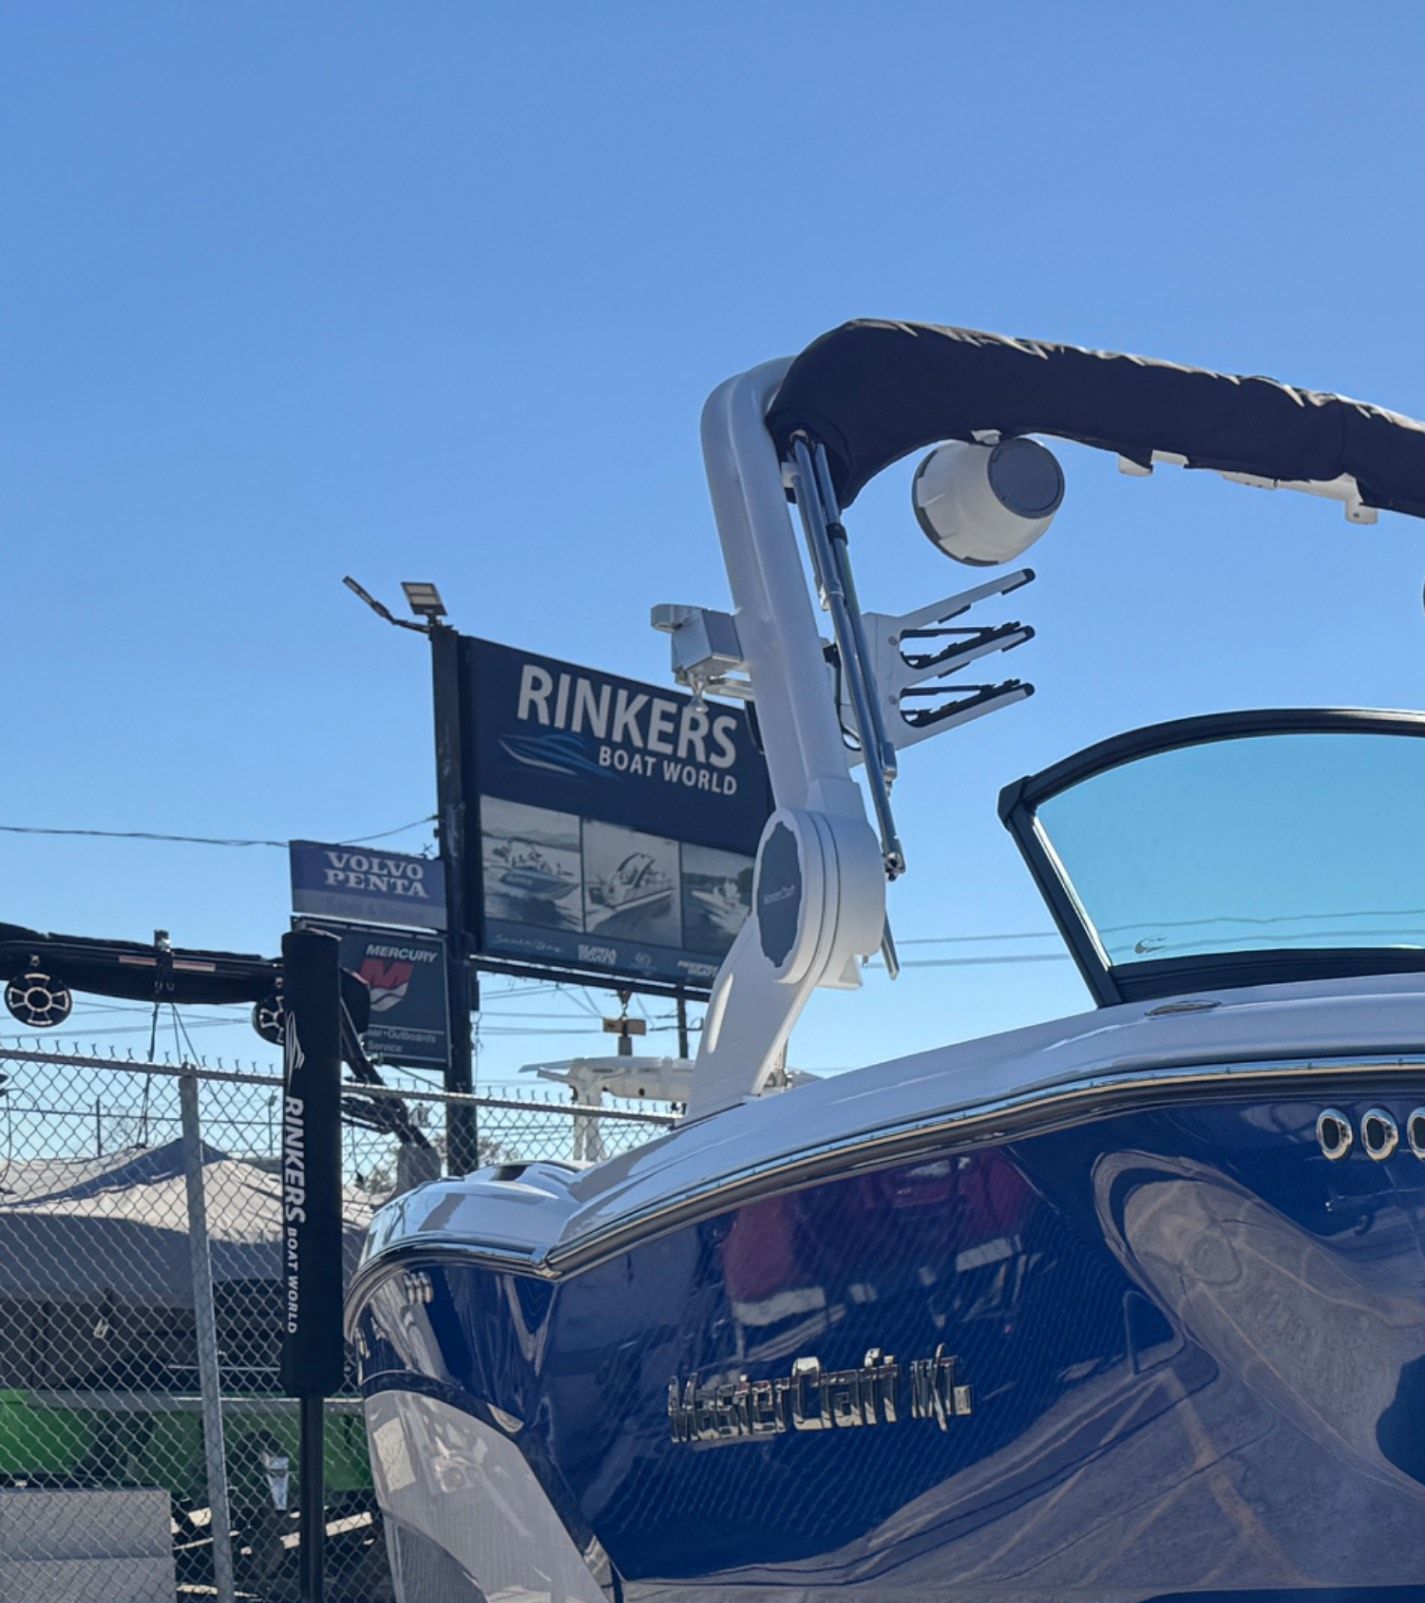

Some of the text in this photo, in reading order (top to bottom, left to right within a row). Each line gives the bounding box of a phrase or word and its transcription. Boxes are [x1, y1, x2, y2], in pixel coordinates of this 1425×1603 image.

[517, 664, 738, 769] RINKERS
[599, 745, 738, 795] BOAT WORLD
[324, 851, 424, 880] VOLVO
[324, 869, 429, 898] PENTA
[366, 944, 438, 963] MERCURY
[285, 1095, 306, 1334] RINKERS BOAT WORLD
